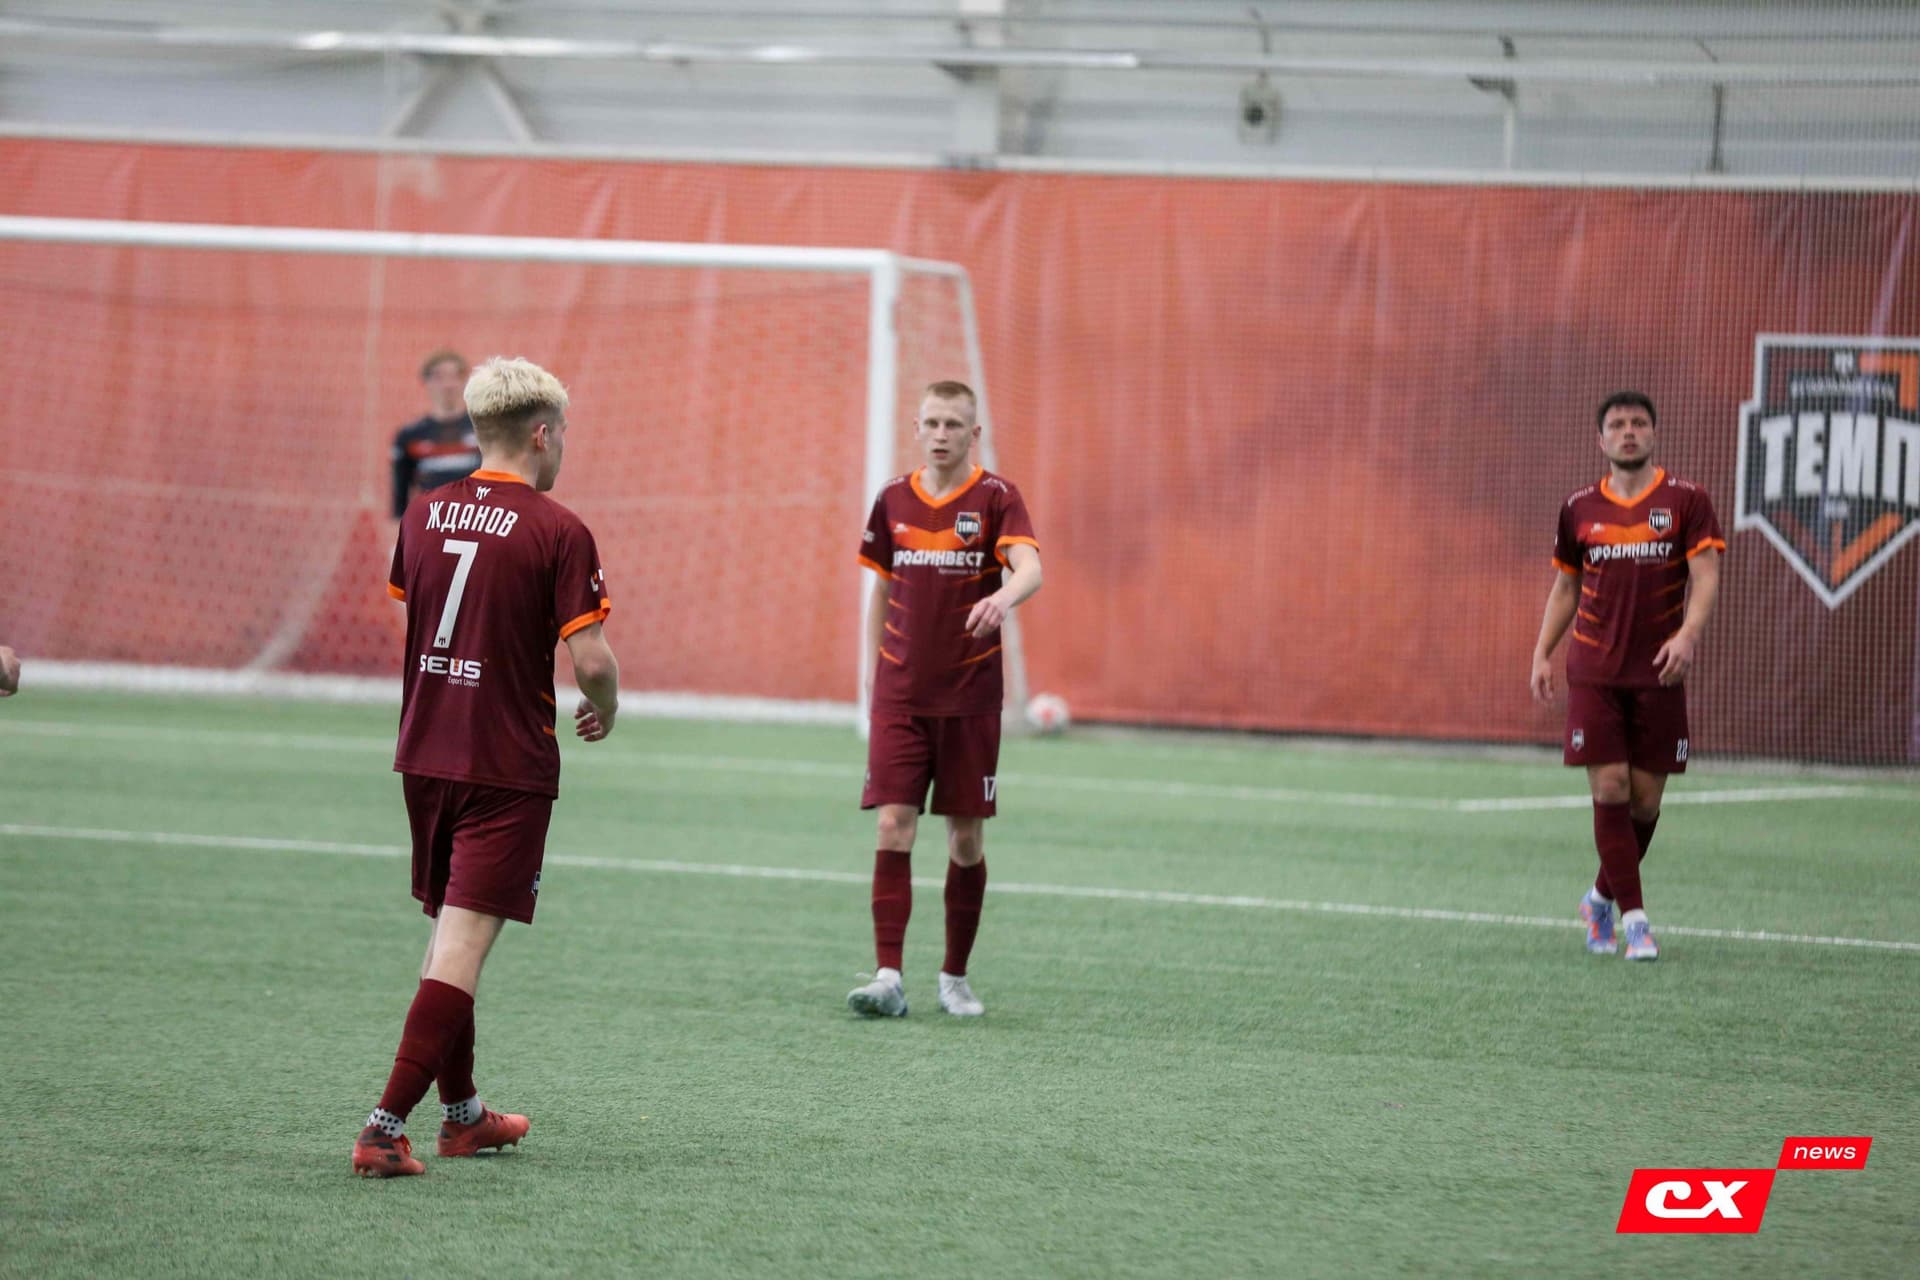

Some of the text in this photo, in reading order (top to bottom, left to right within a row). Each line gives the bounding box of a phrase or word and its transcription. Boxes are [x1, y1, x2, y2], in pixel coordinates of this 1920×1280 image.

[1759, 410, 1920, 508] ТЕМП
[425, 500, 519, 537] ЖДАНОВ
[433, 538, 479, 649] 7
[420, 654, 481, 679] SEUS
[982, 775, 997, 802] 17
